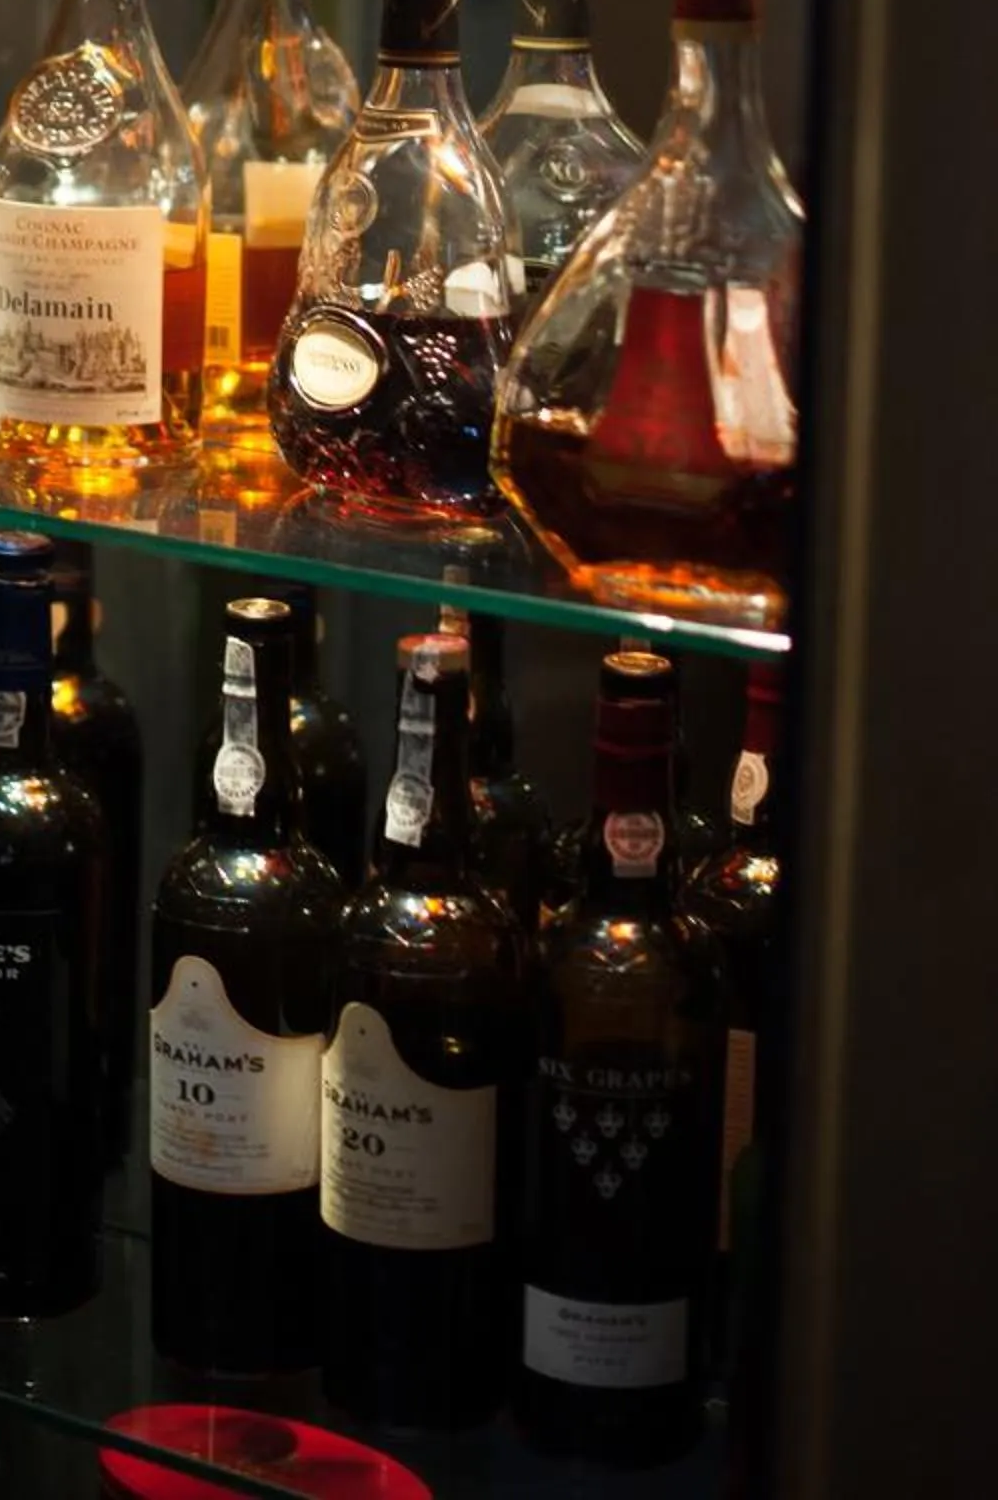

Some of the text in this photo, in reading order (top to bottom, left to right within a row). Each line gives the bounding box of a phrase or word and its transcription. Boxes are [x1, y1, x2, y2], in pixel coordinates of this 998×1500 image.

[31, 235, 138, 251] CHAMPAGNE
[153, 1034, 265, 1073] GRAHAM'S
[538, 1055, 693, 1090] SIX GRAPES
[177, 1078, 215, 1106] 10
[342, 1127, 386, 1157] 20
